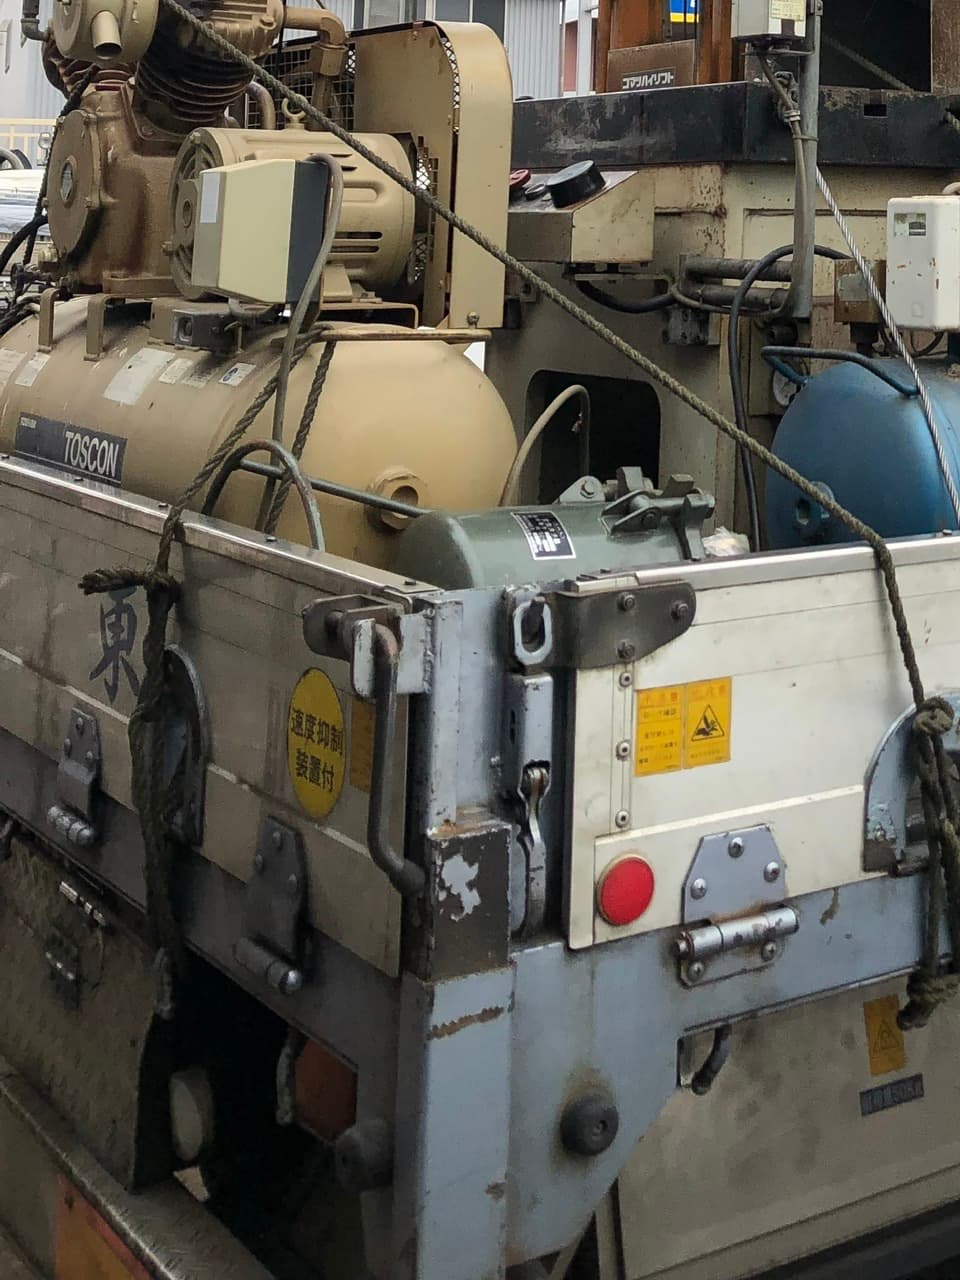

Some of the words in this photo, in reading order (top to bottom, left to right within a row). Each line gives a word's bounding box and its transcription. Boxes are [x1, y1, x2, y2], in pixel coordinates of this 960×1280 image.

[622, 71, 674, 90] コマツハイリフト
[64, 430, 120, 478] TOSCON
[290, 708, 344, 756] 速度抑制
[295, 748, 335, 793] 装置付
